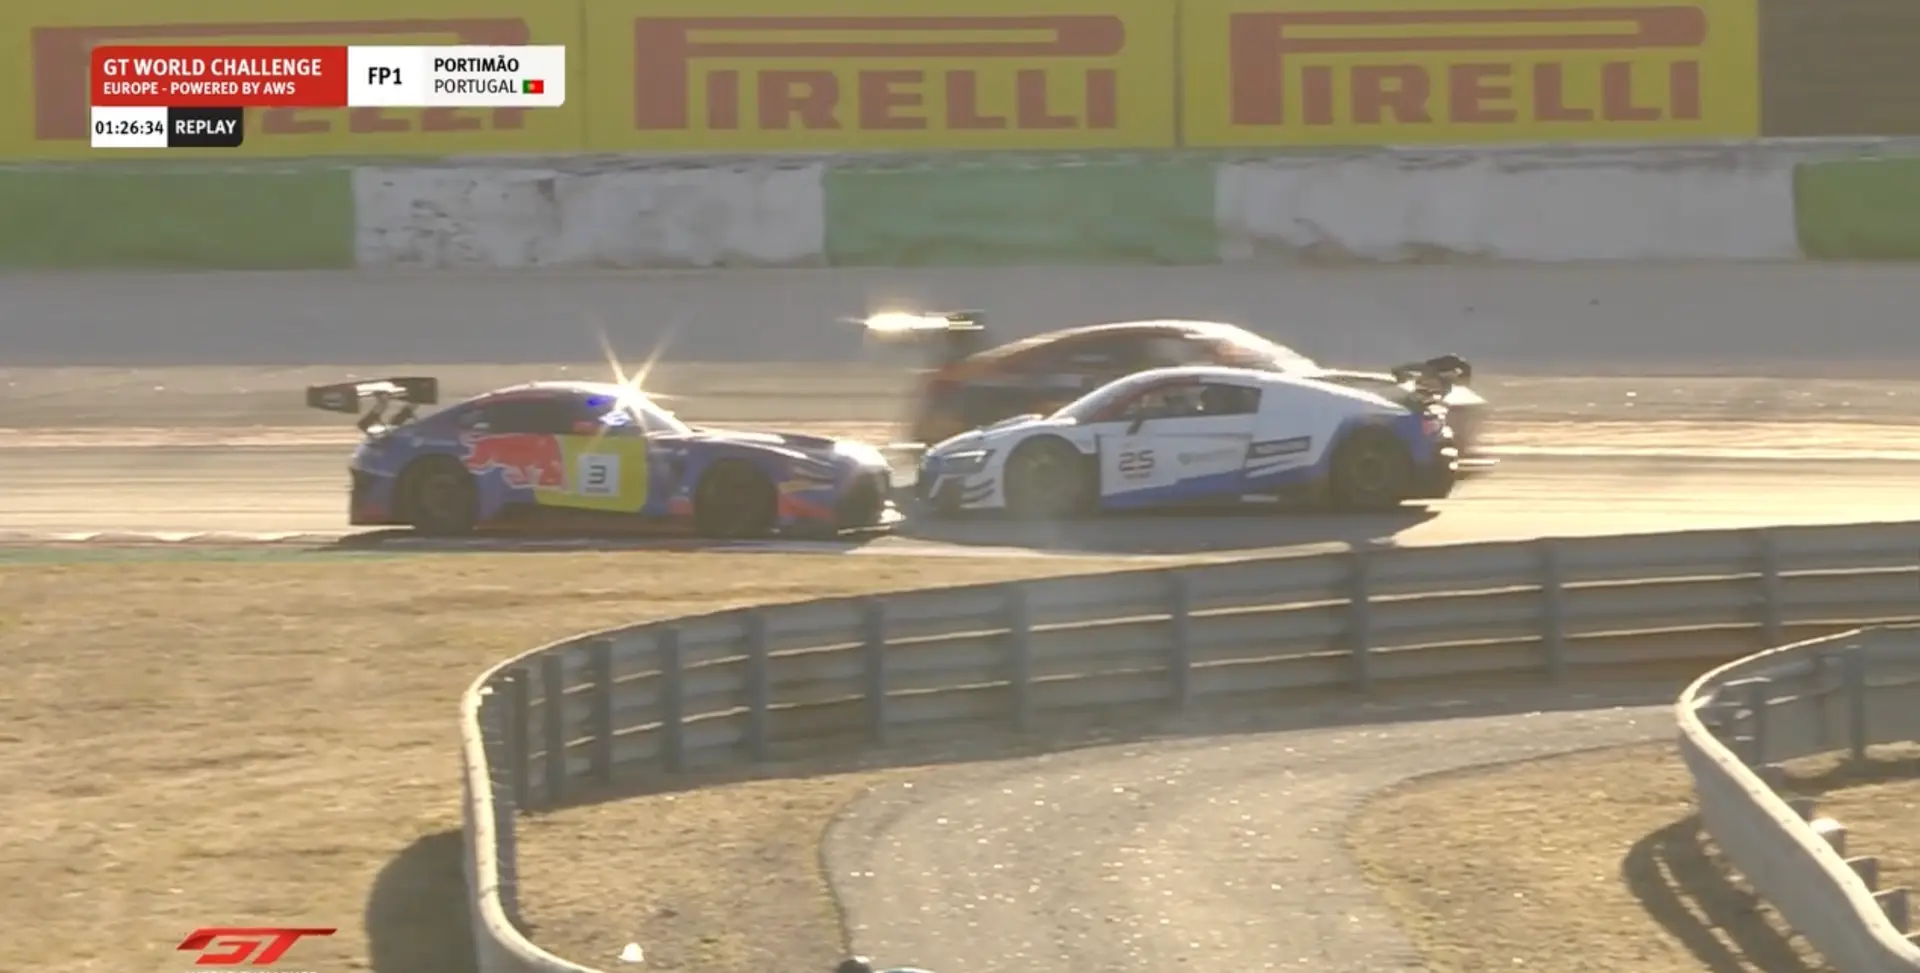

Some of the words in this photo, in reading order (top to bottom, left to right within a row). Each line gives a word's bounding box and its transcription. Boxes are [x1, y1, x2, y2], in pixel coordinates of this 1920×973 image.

[634, 15, 1126, 130] PIRELLI
[1229, 6, 1708, 125] PIRELLI
[588, 465, 606, 484] 3
[1119, 450, 1155, 472] 25
